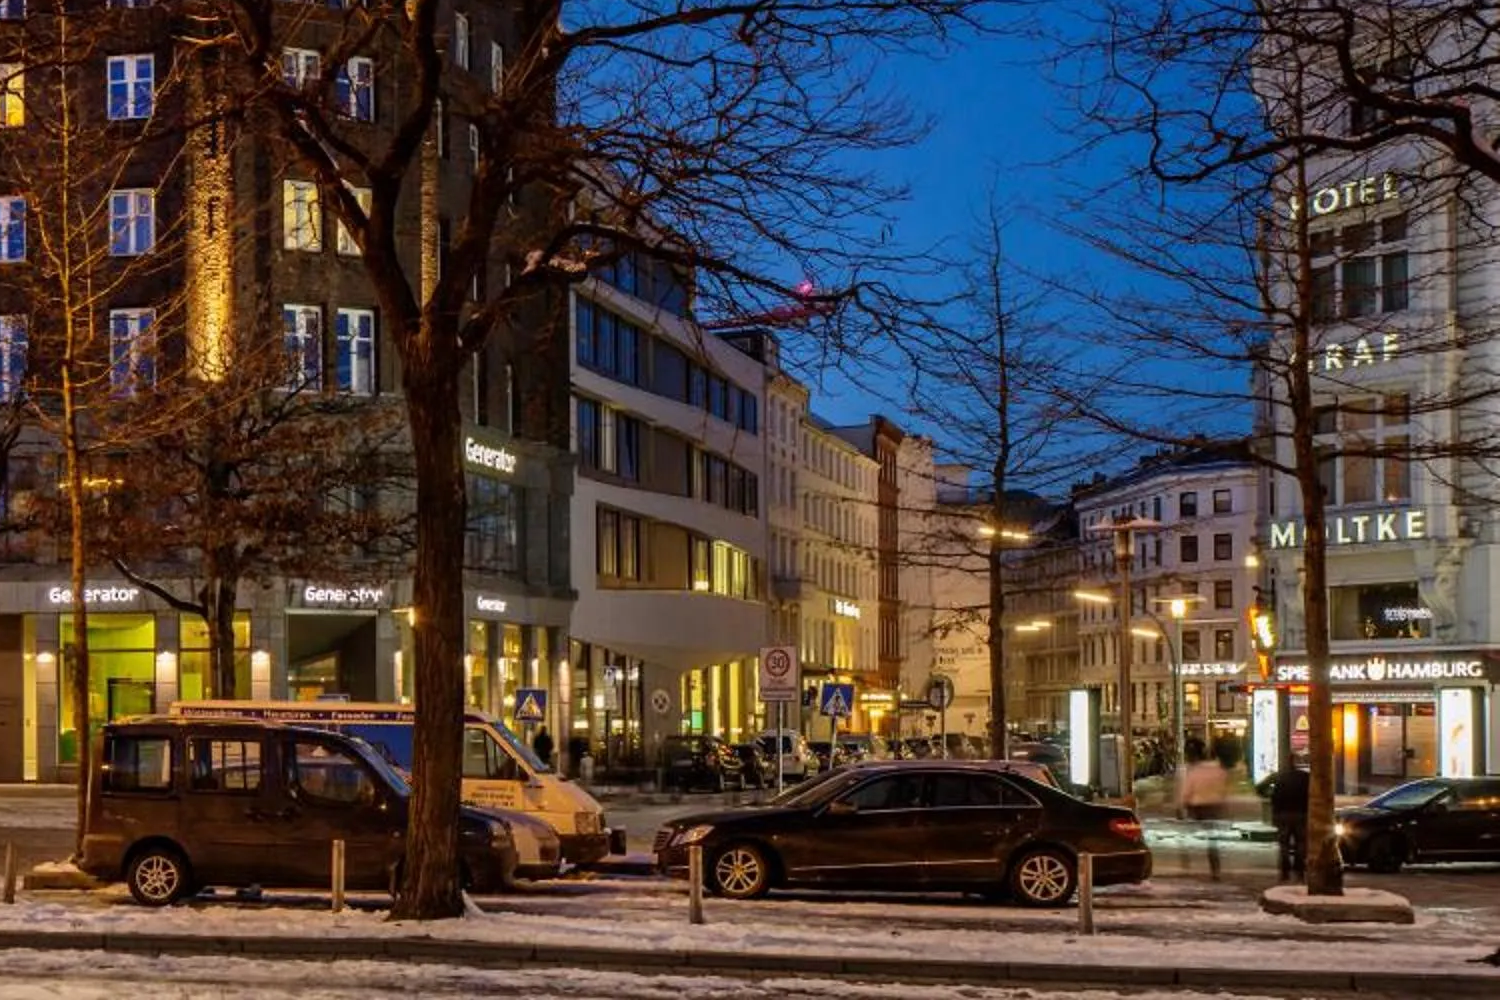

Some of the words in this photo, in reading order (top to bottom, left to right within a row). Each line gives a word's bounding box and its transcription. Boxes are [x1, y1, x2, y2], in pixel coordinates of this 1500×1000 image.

[1289, 332, 1399, 373] RAF
[49, 586, 140, 603] Geerator
[305, 586, 383, 602] Generator
[1277, 663, 1366, 681] SPIEANK
[1387, 660, 1483, 679] HAMBURG
